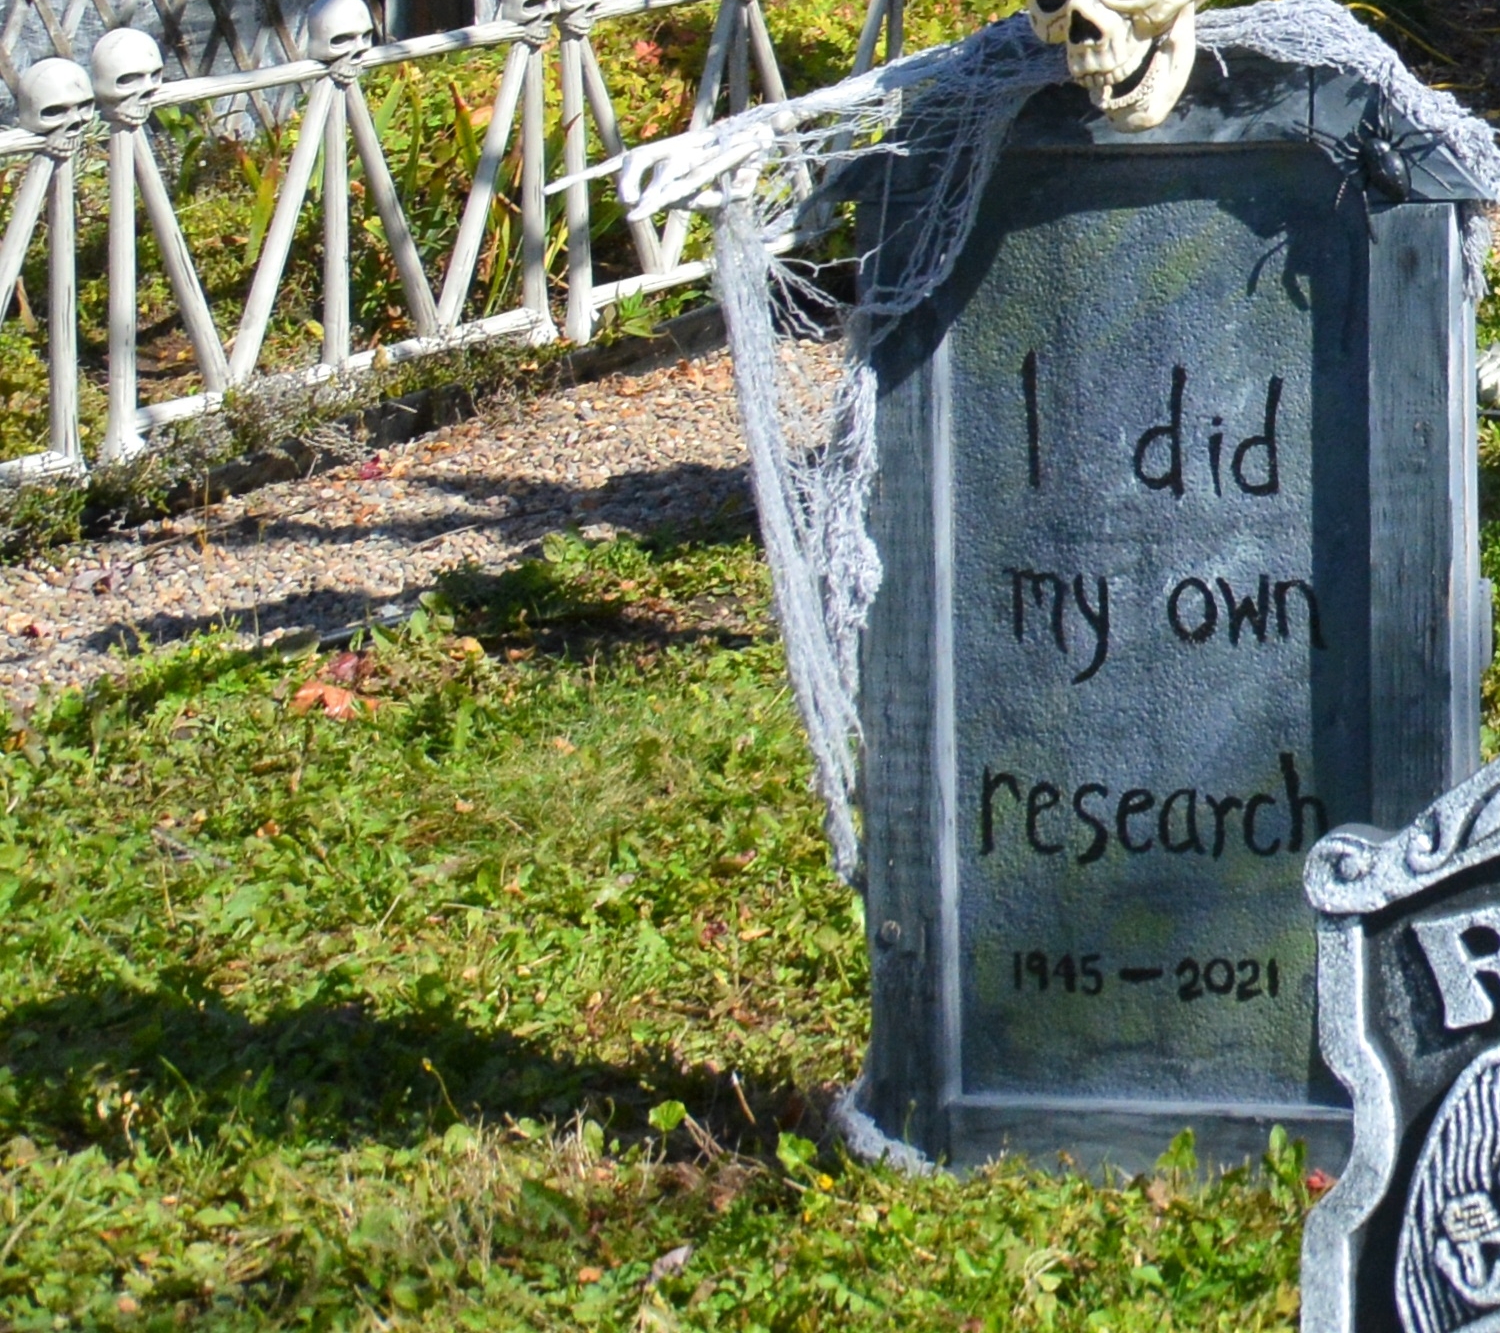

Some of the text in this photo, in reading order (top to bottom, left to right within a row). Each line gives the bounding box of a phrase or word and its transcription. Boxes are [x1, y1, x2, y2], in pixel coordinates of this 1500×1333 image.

[1020, 349, 1284, 500] I did
[1003, 566, 1330, 686] my own
[978, 752, 1331, 865] research
